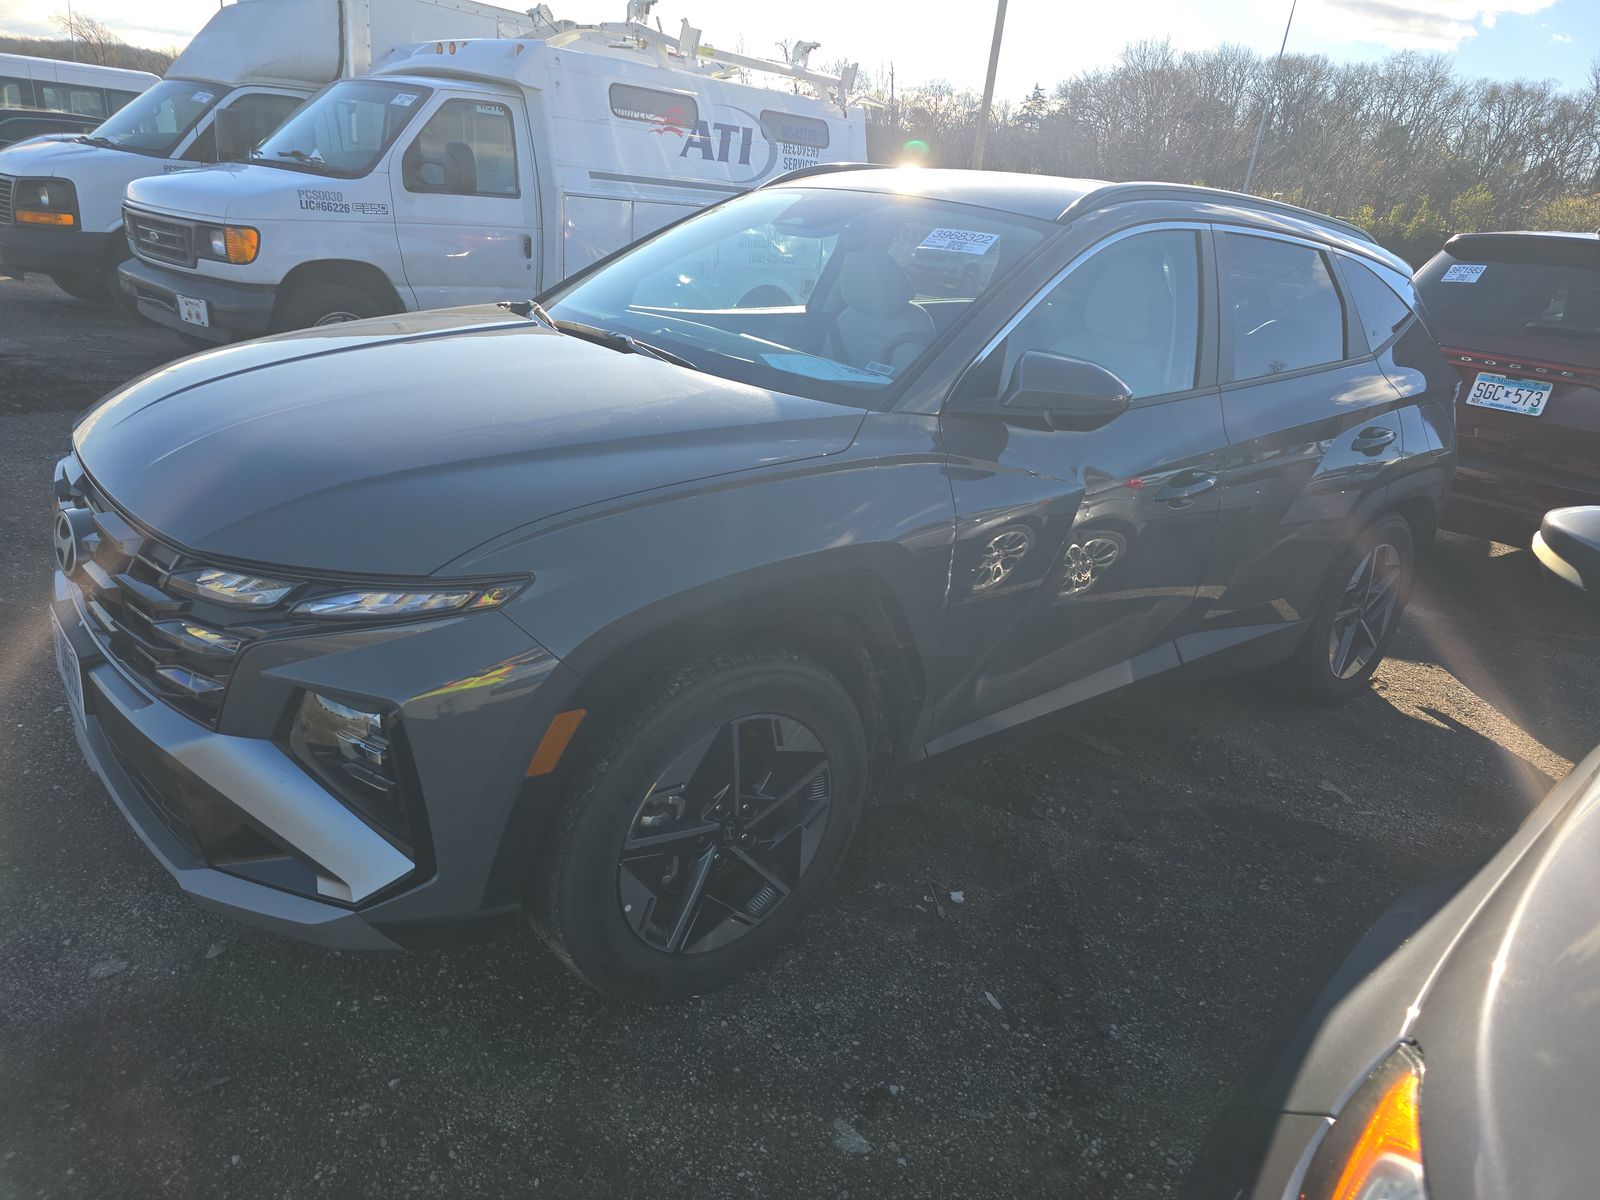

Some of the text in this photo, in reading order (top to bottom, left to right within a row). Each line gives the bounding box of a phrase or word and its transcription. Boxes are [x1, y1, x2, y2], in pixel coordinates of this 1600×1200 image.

[679, 119, 753, 165] ATI
[297, 189, 343, 202] PCS0030
[299, 200, 350, 214] LIC#66226
[932, 229, 994, 245] 3968322
[1460, 355, 1574, 377] DODGE
[1473, 382, 1505, 401] SGC
[1512, 388, 1544, 408] 573
